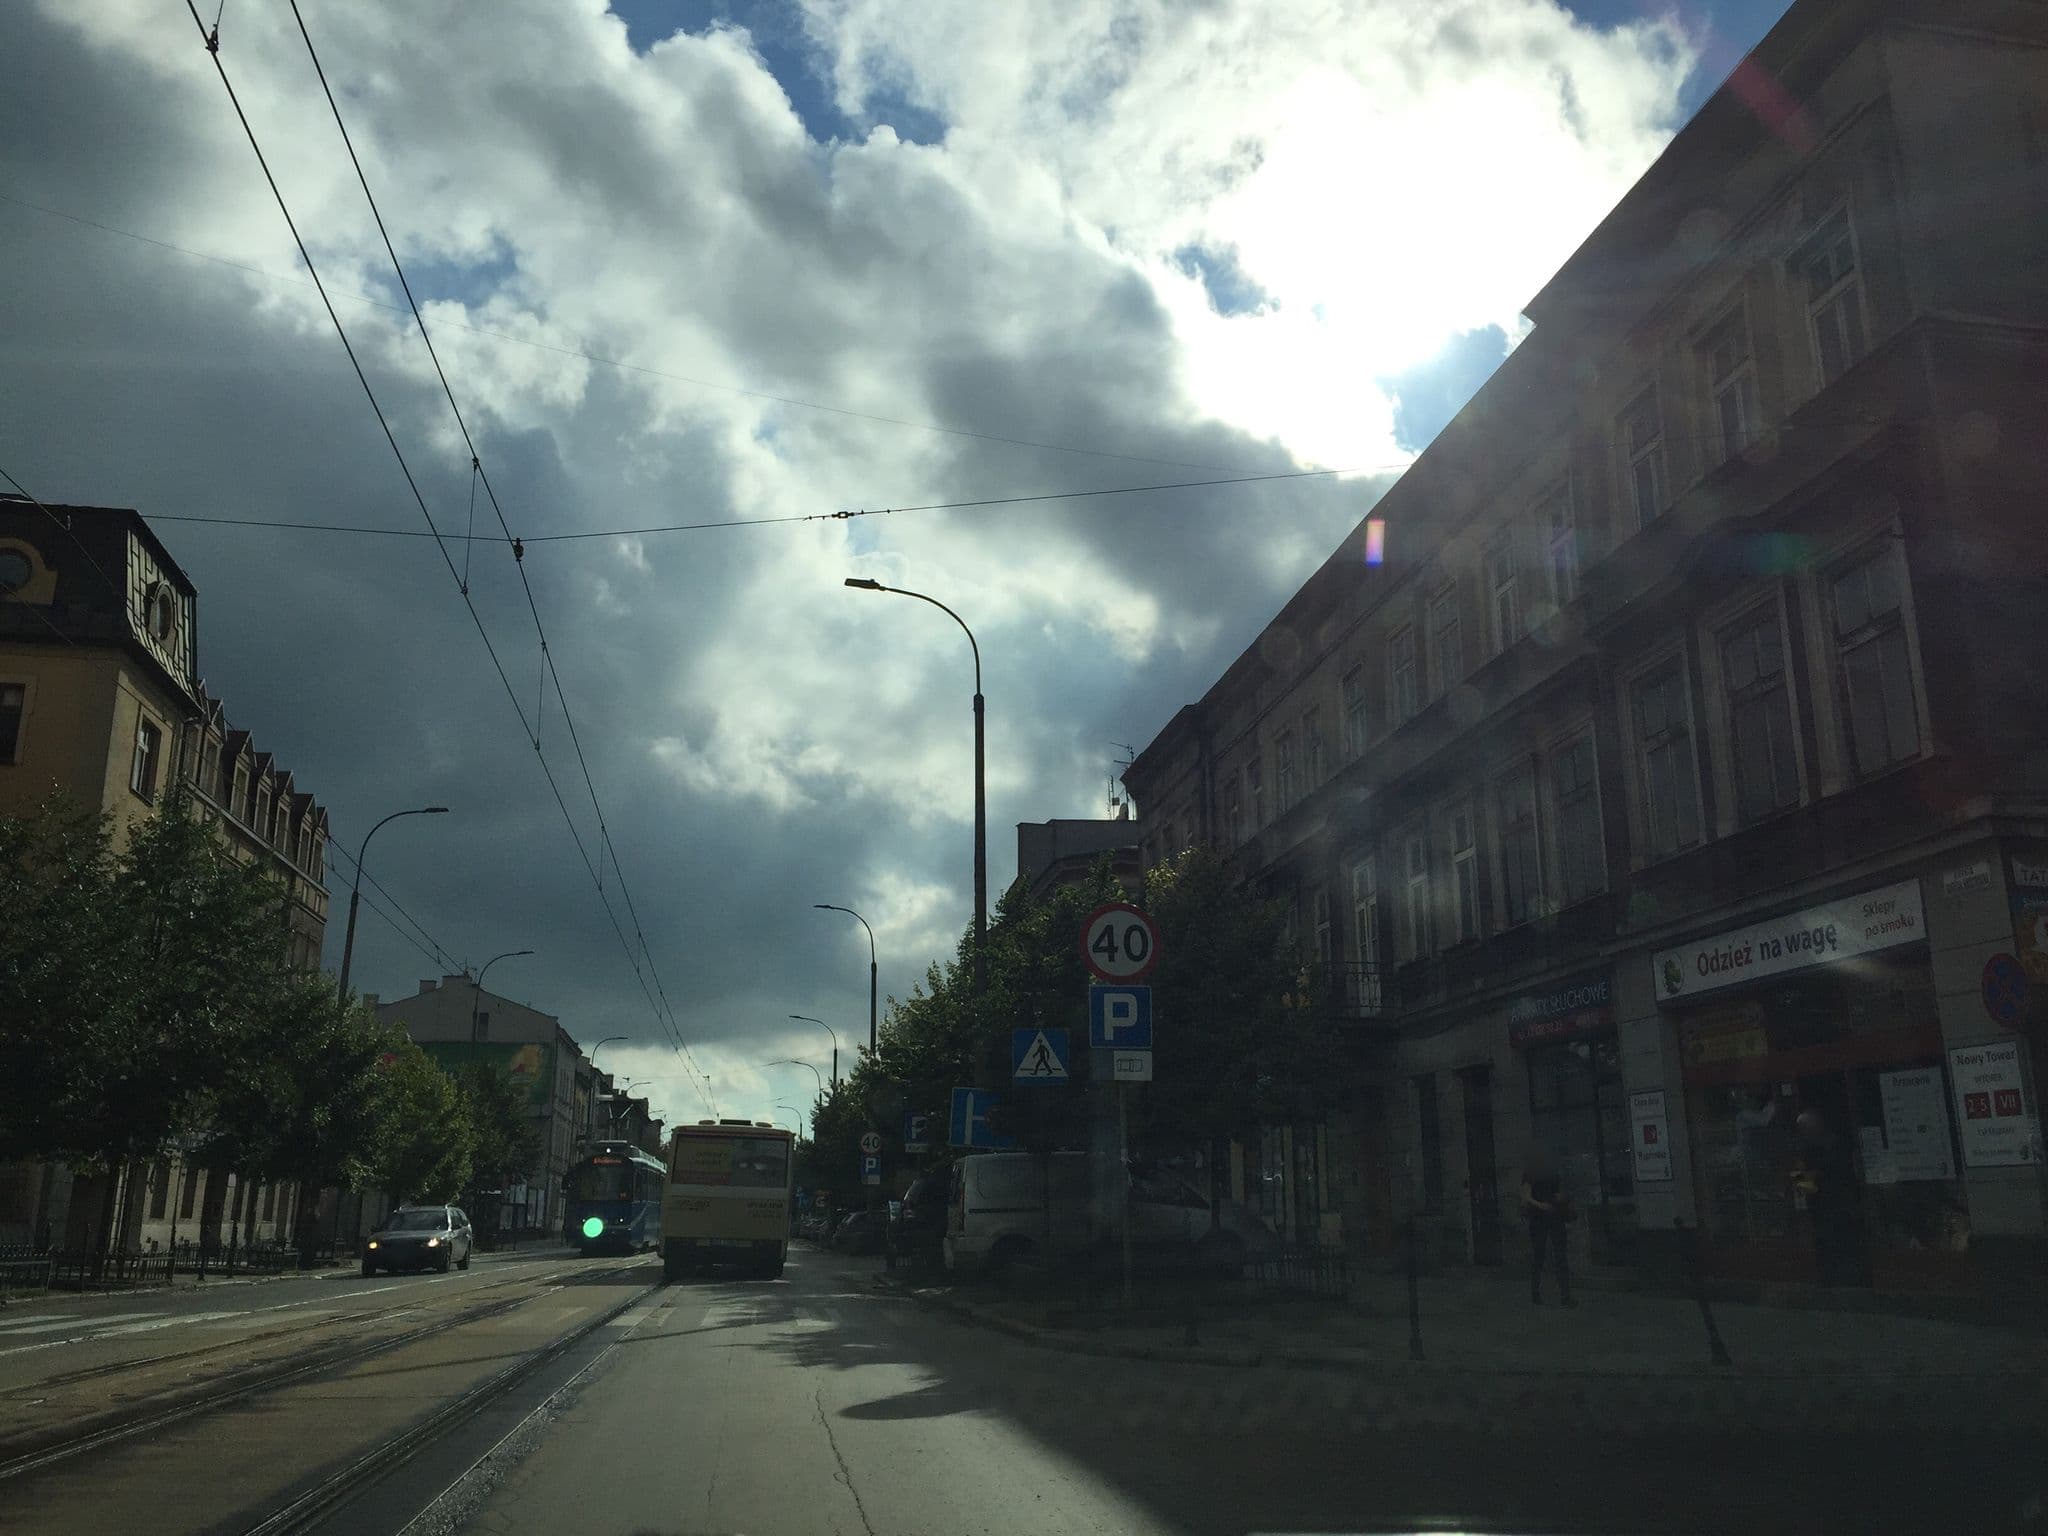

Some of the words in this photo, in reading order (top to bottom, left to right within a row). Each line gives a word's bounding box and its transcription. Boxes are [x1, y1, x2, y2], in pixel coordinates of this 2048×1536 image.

[1862, 898, 1895, 919] Sklepy
[1865, 924, 1880, 940] po
[1092, 924, 1149, 962] 40
[1697, 939, 1753, 977] Odzież
[1759, 940, 1782, 962] na
[1784, 923, 1837, 955] wagę
[1103, 993, 1138, 1041] P
[1956, 1054, 1984, 1066] Nowy
[1985, 1049, 2016, 1064] Towar
[862, 1136, 881, 1149] 40
[865, 1158, 877, 1173] P
